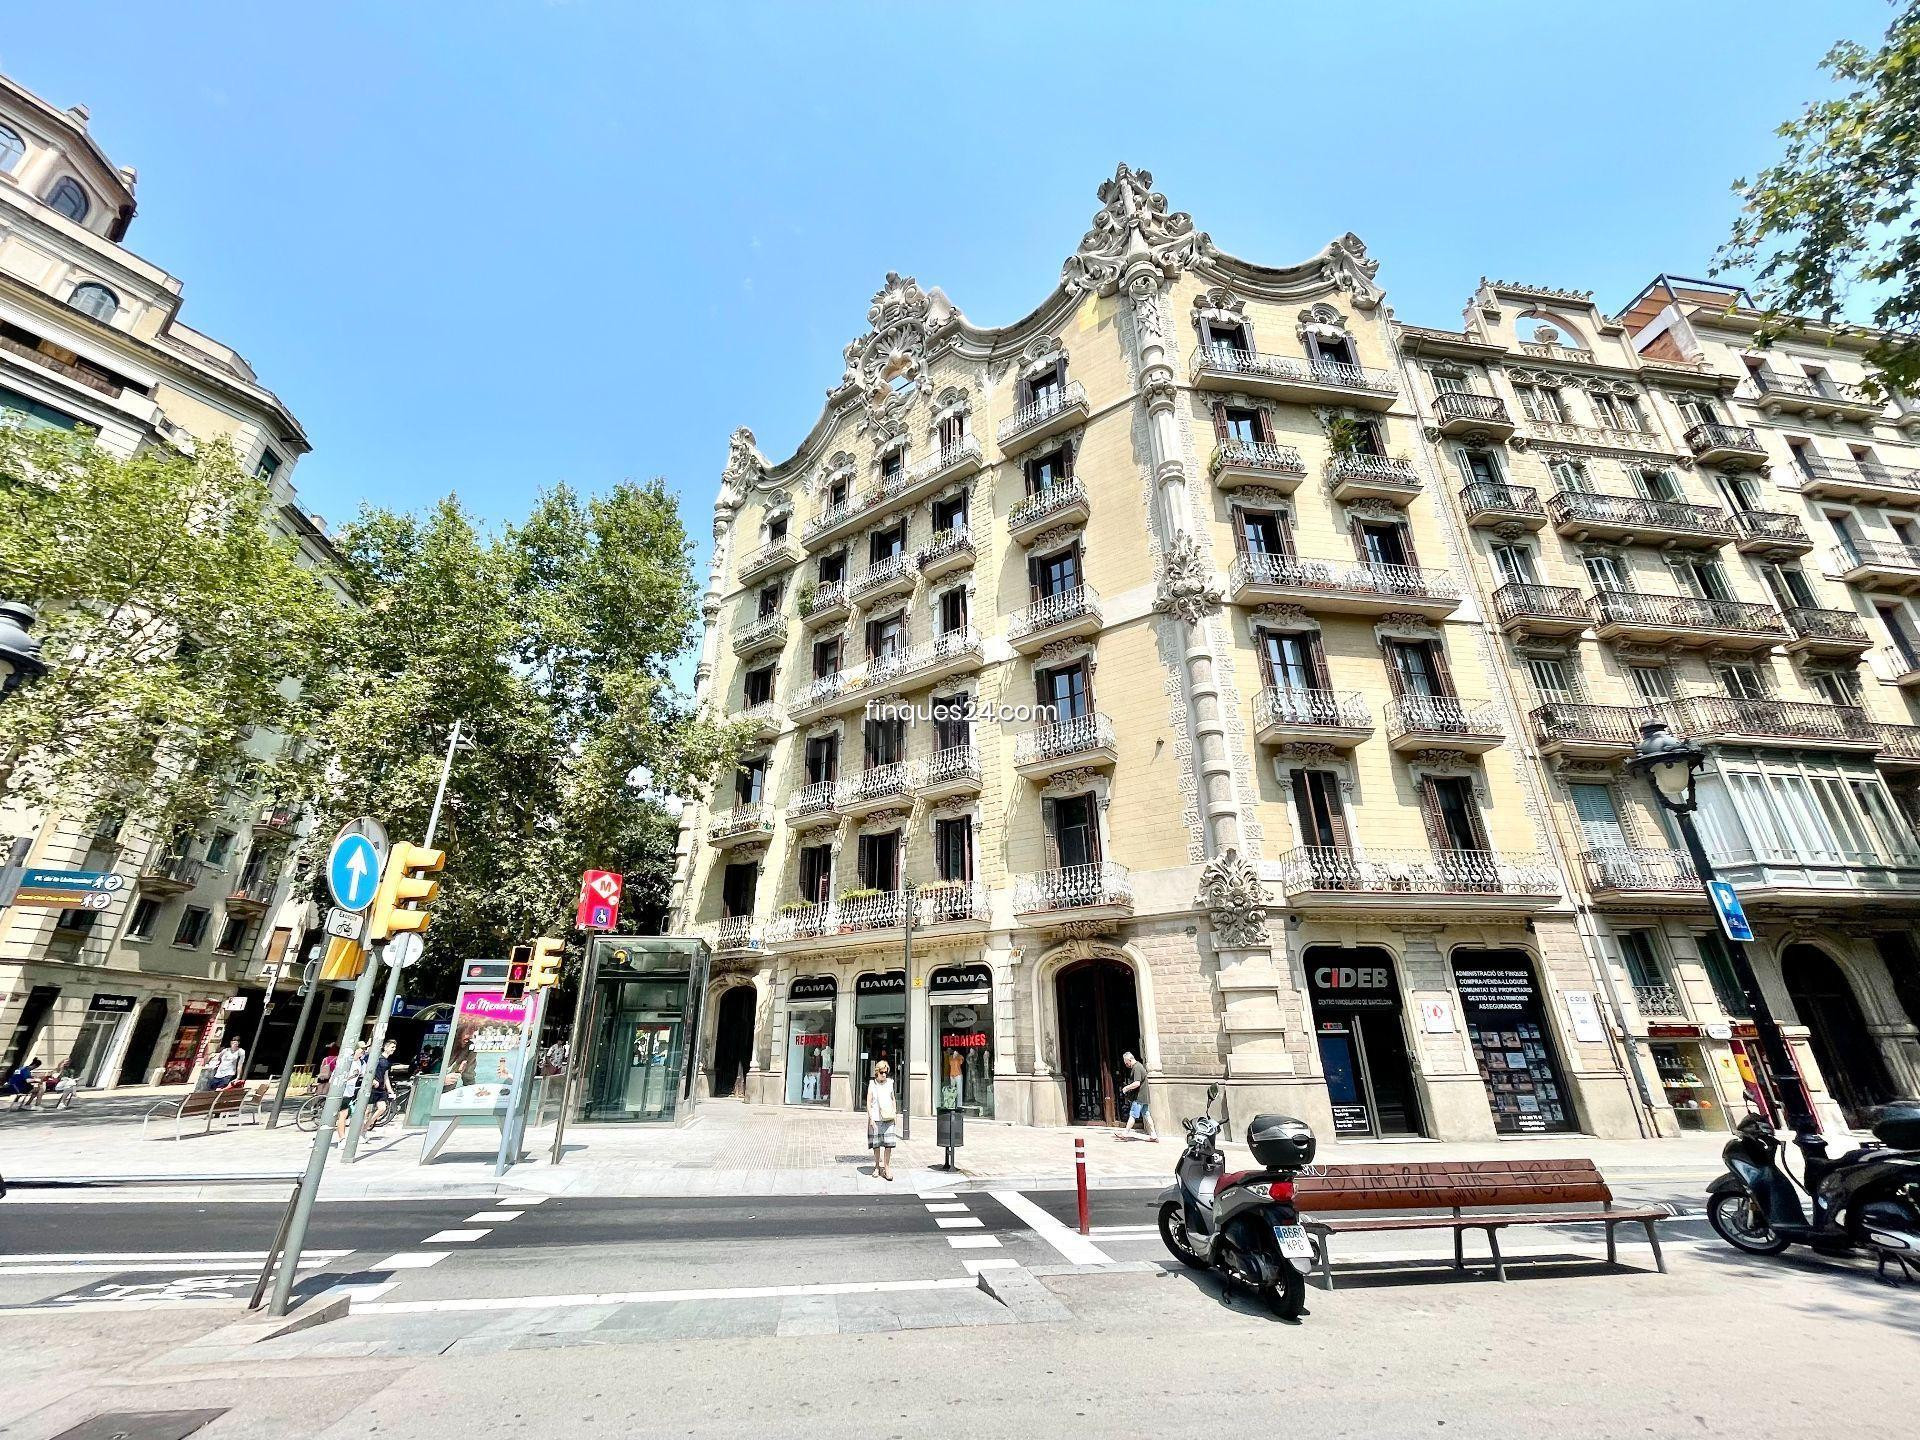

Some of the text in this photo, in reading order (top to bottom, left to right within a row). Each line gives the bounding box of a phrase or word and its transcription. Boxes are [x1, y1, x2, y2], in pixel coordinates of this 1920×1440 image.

[600, 880, 612, 892] M
[1718, 889, 1733, 910] P
[860, 978, 905, 989] DAMA
[936, 973, 988, 984] DAMA
[1314, 966, 1388, 989] CIDEB
[795, 983, 834, 993] DAMA
[942, 1032, 987, 1047] REBAIXES
